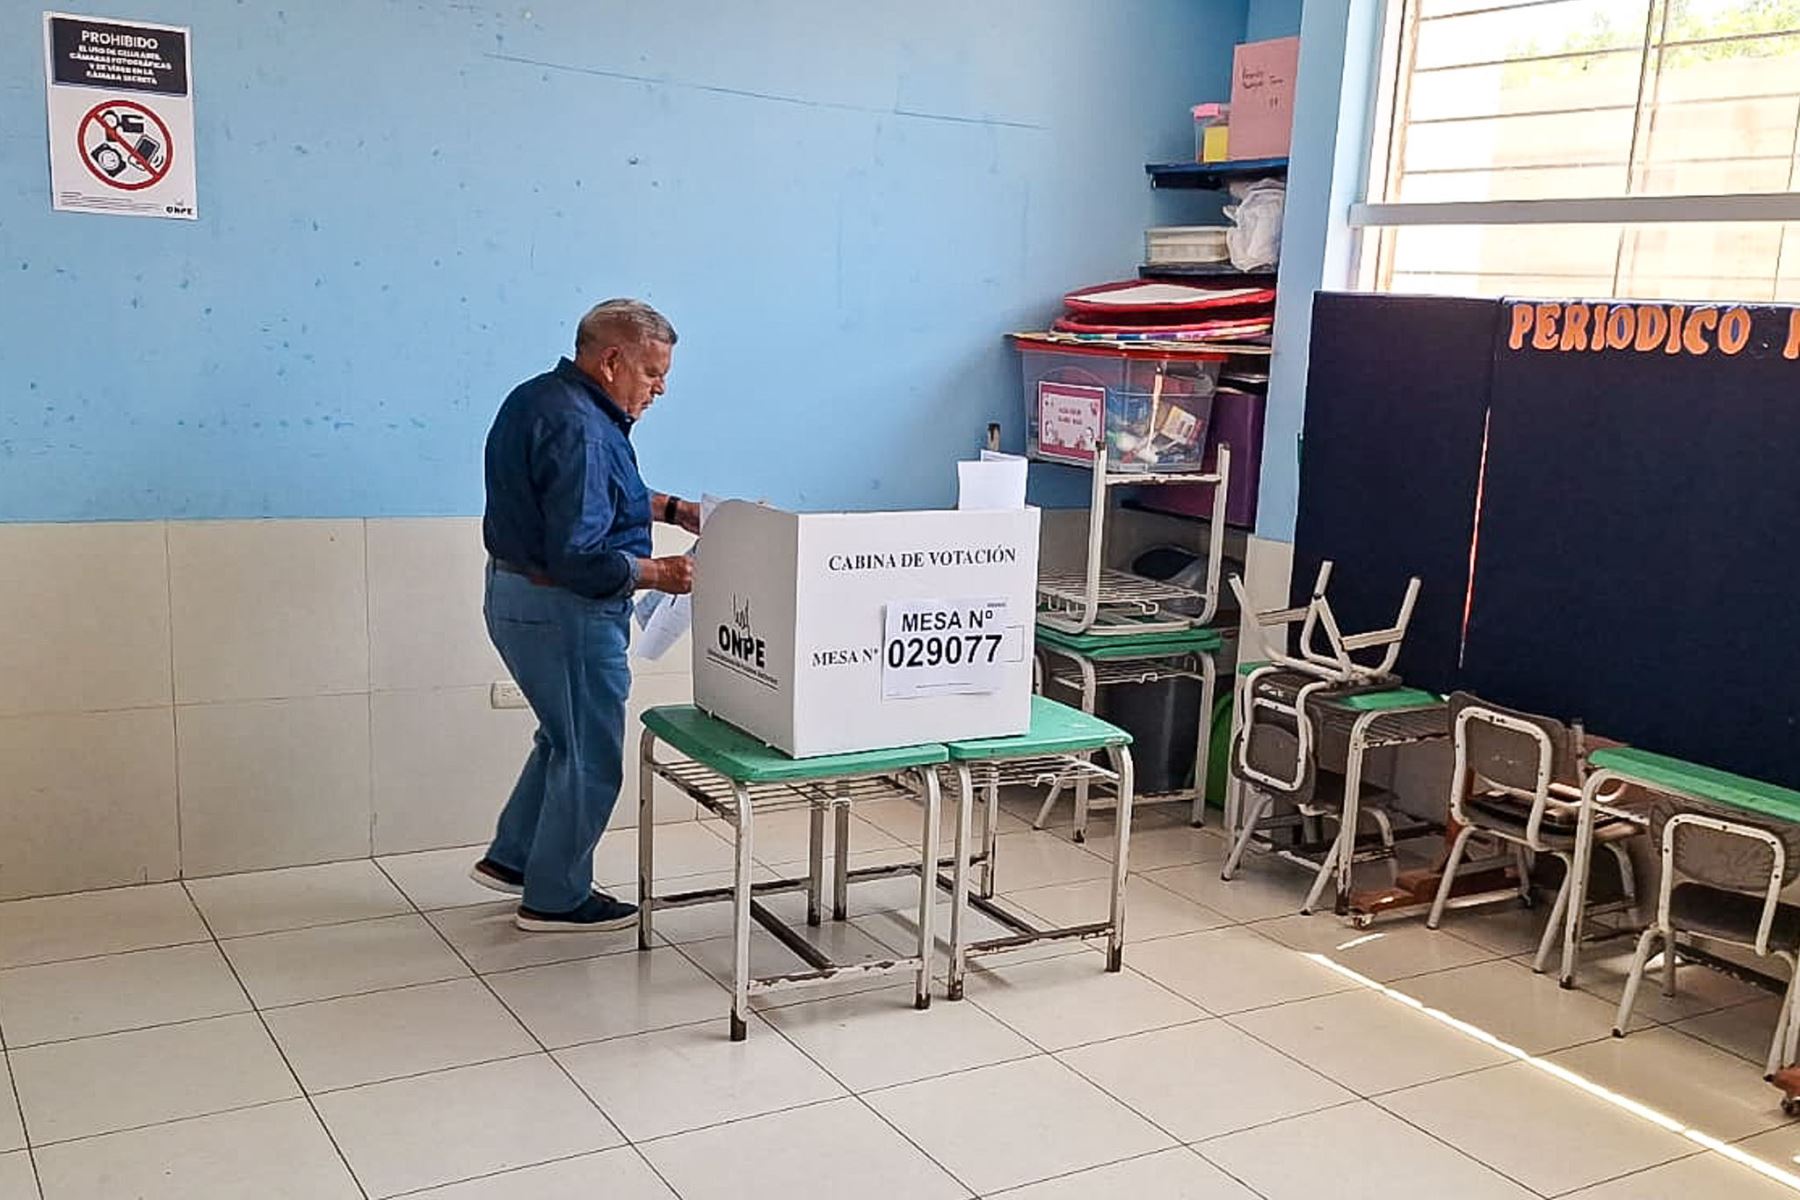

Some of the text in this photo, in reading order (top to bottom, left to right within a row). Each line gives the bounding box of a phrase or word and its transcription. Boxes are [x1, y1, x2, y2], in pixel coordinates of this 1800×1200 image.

[81, 30, 159, 49] PROHIBIDO
[88, 46, 105, 54] USO
[165, 205, 193, 215] ONPE
[1508, 303, 1751, 355] PERIODICO
[828, 545, 1016, 571] CABINA DE VOTACIÓN
[902, 611, 962, 632] MESA
[718, 625, 766, 669] ONPE
[888, 635, 1003, 668] 029077
[812, 650, 859, 668] MESA
